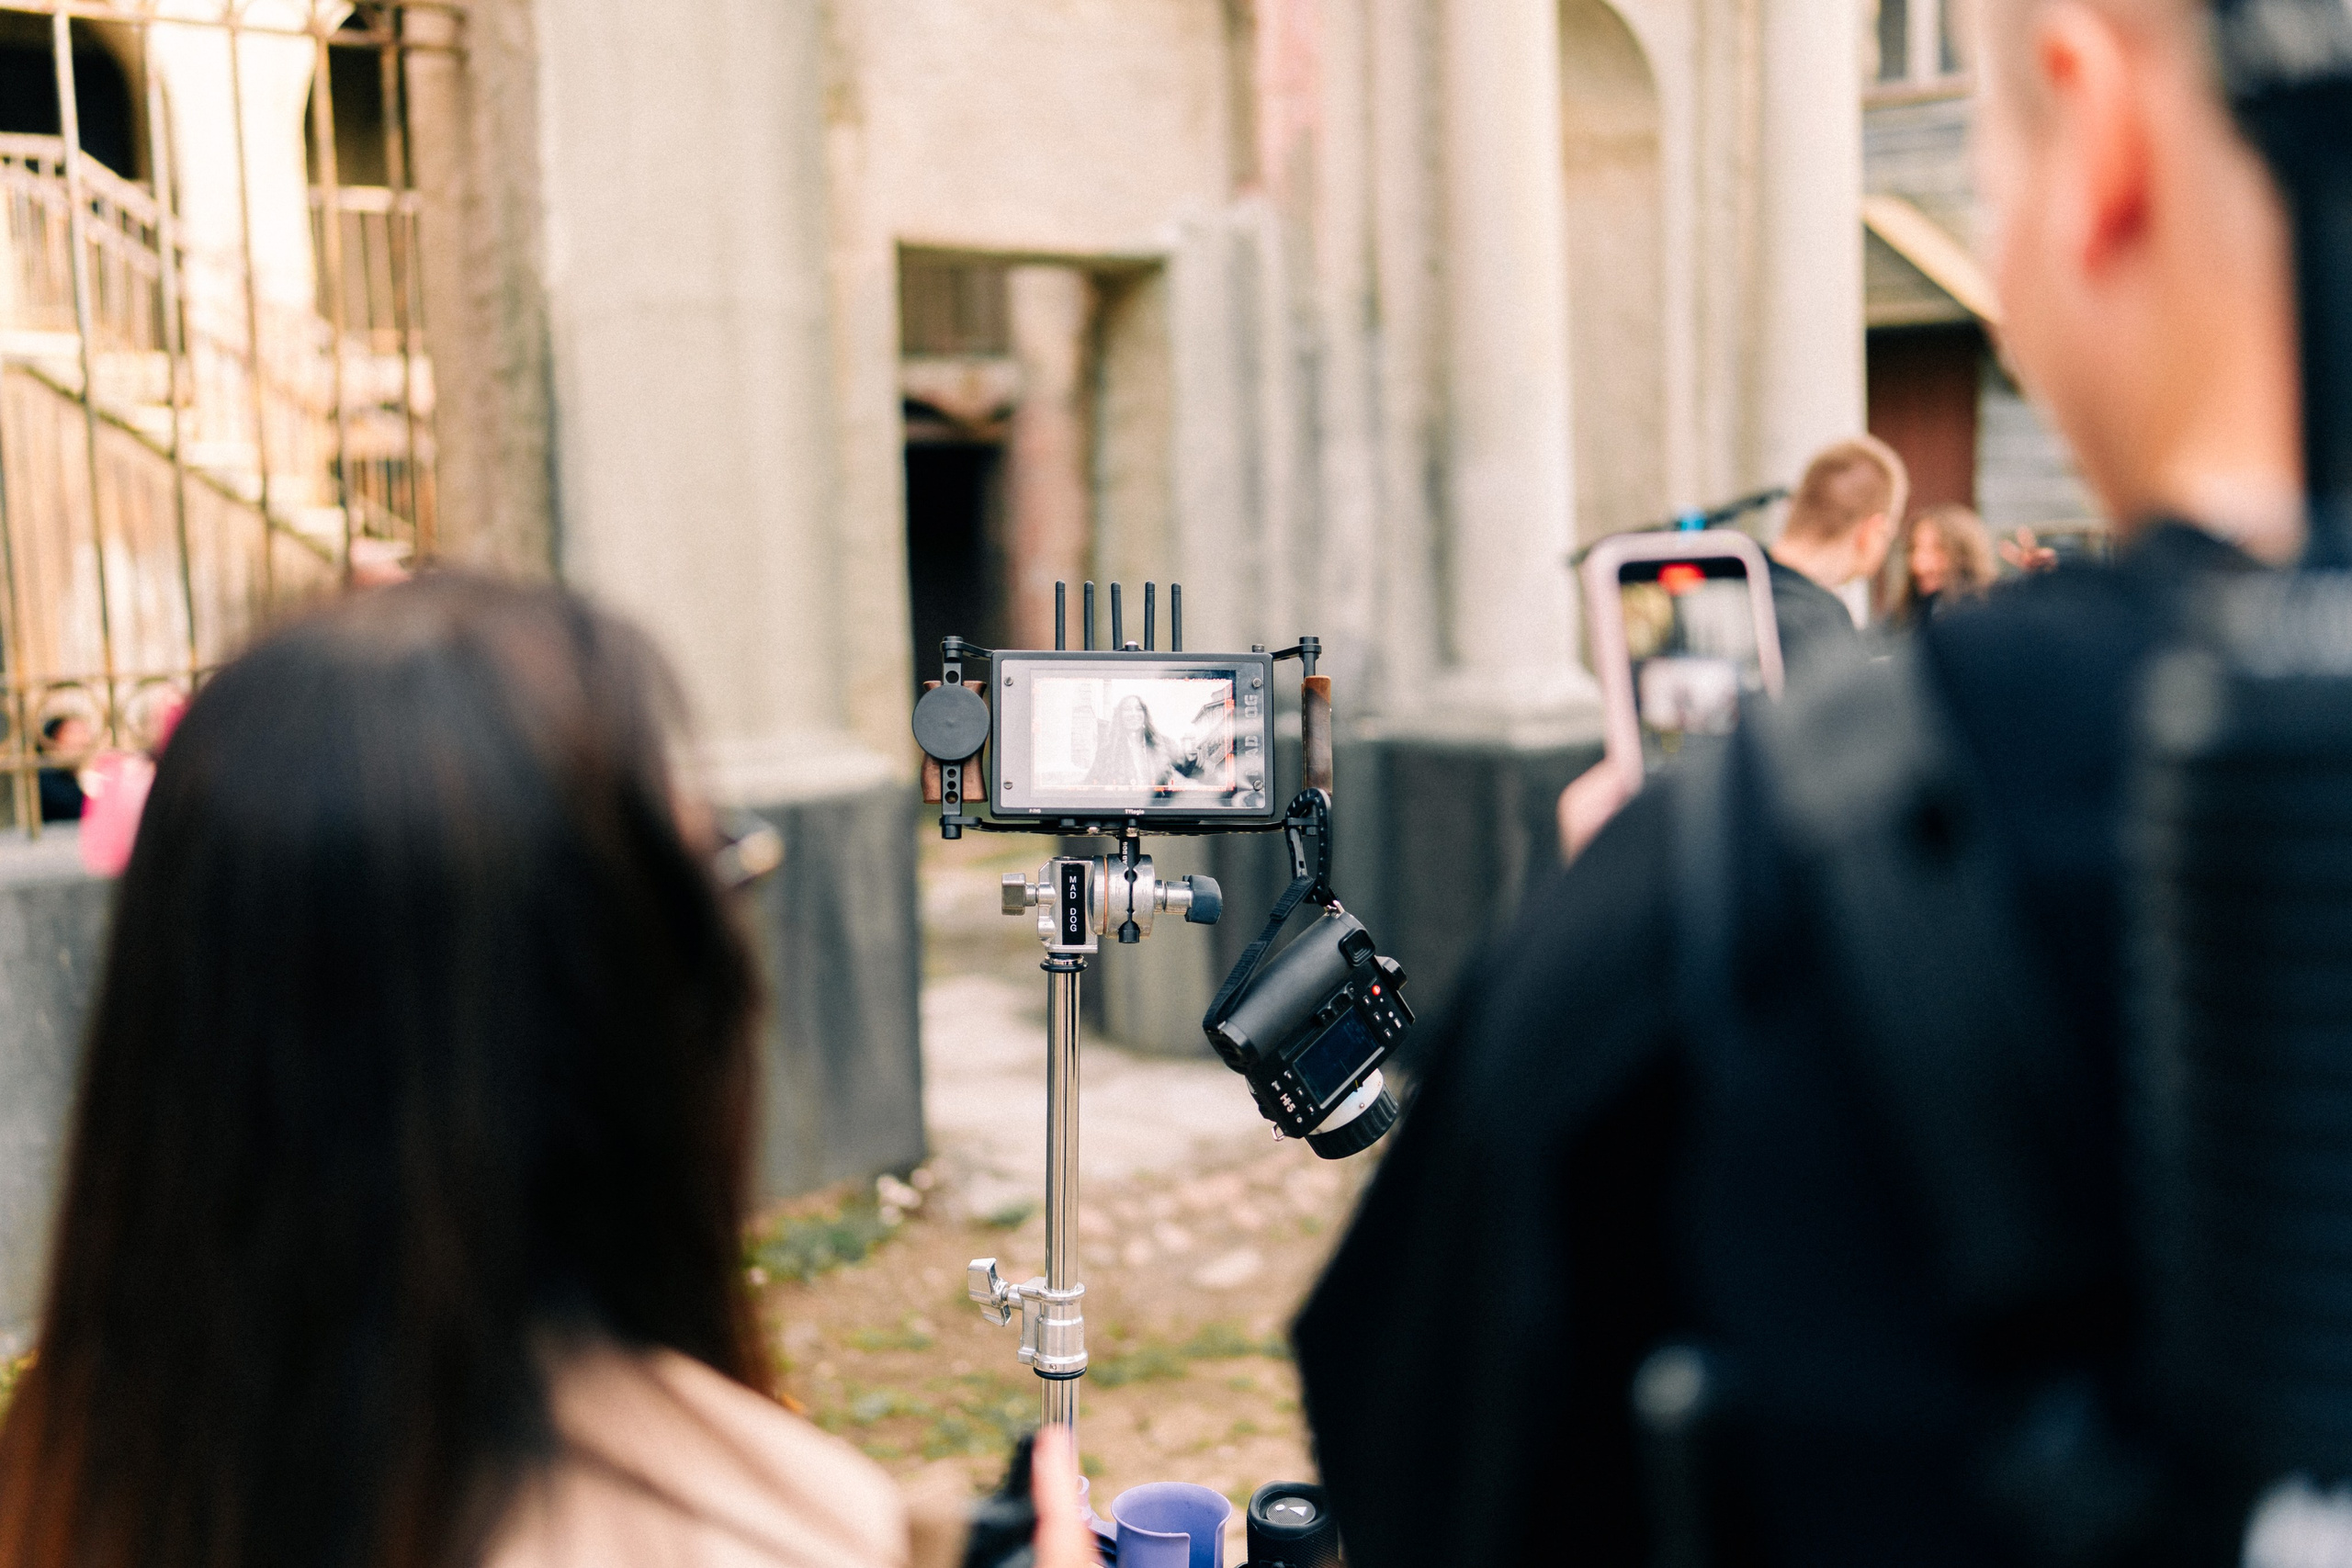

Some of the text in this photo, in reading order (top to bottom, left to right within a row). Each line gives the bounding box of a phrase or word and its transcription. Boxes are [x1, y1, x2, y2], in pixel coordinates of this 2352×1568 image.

[1244, 694, 1259, 725] OG
[1069, 875, 1078, 932] MAD DOG
